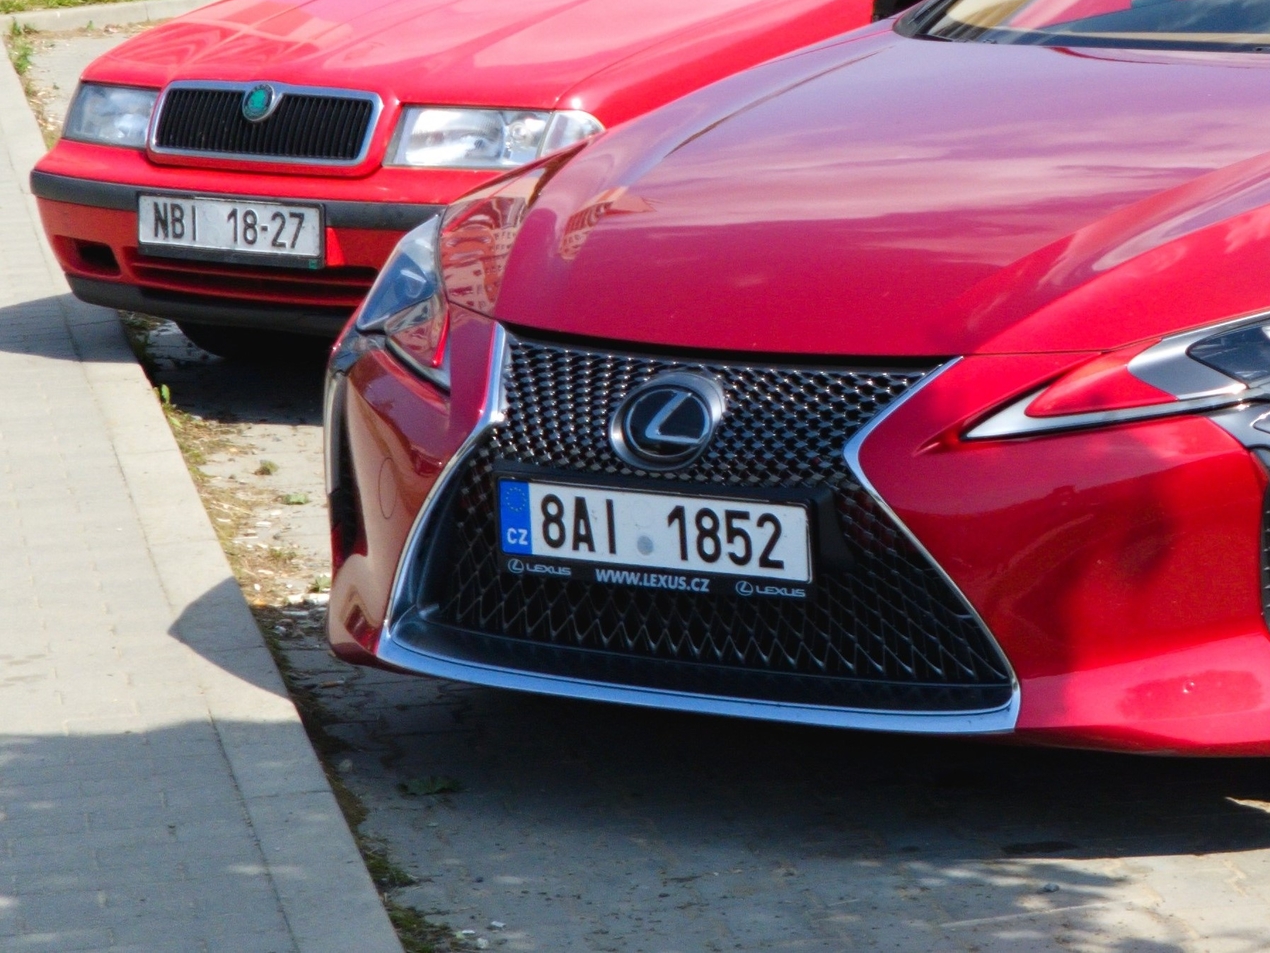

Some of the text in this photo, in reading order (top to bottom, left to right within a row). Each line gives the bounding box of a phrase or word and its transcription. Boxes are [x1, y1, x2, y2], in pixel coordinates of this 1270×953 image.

[153, 201, 305, 249] NBI 18-27
[507, 527, 529, 546] CZ
[540, 493, 785, 570] 8AI 1852
[526, 563, 572, 577] LEXUS
[595, 568, 710, 593] WWW.LEXUS.CZ
[755, 585, 806, 598] LEXUS
